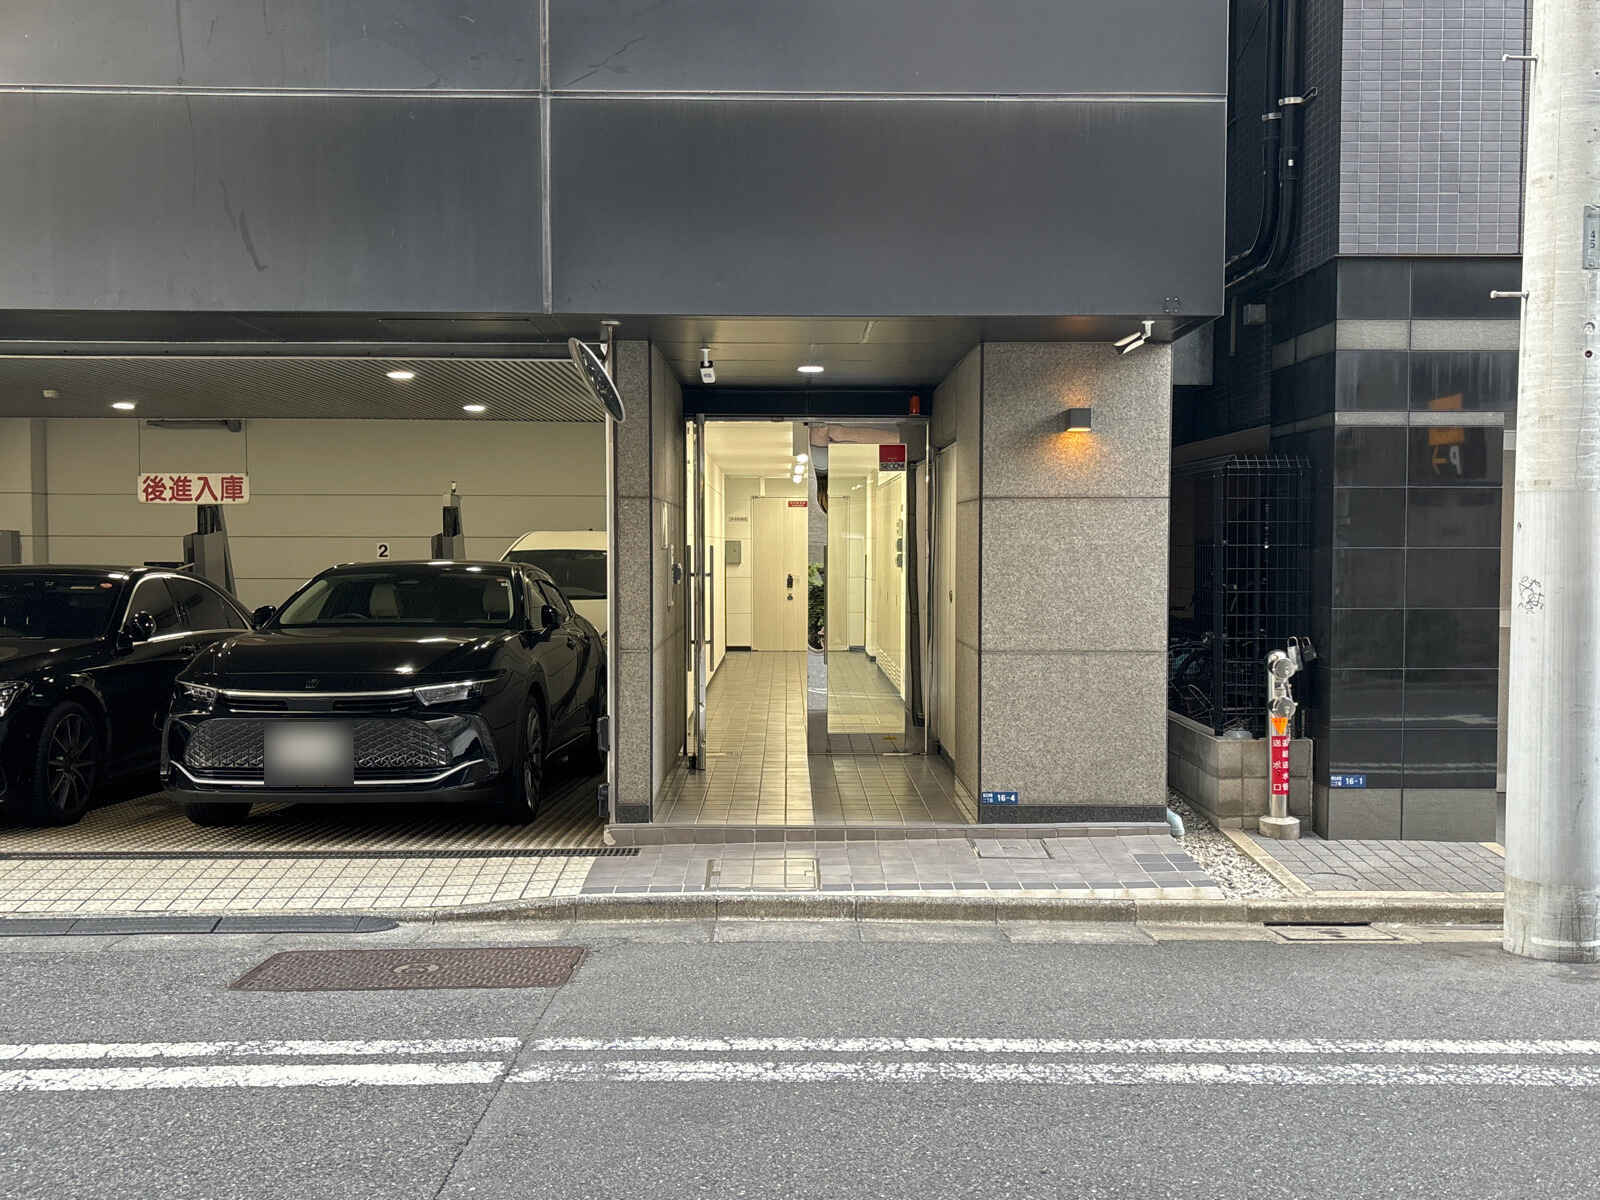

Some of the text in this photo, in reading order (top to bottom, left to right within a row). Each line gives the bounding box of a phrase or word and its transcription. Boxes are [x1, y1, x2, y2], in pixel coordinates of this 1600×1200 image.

[142, 475, 245, 503] 後進入庫
[377, 544, 389, 558] 2
[1345, 776, 1363, 785] 16-1
[997, 794, 1016, 802] 16-4
